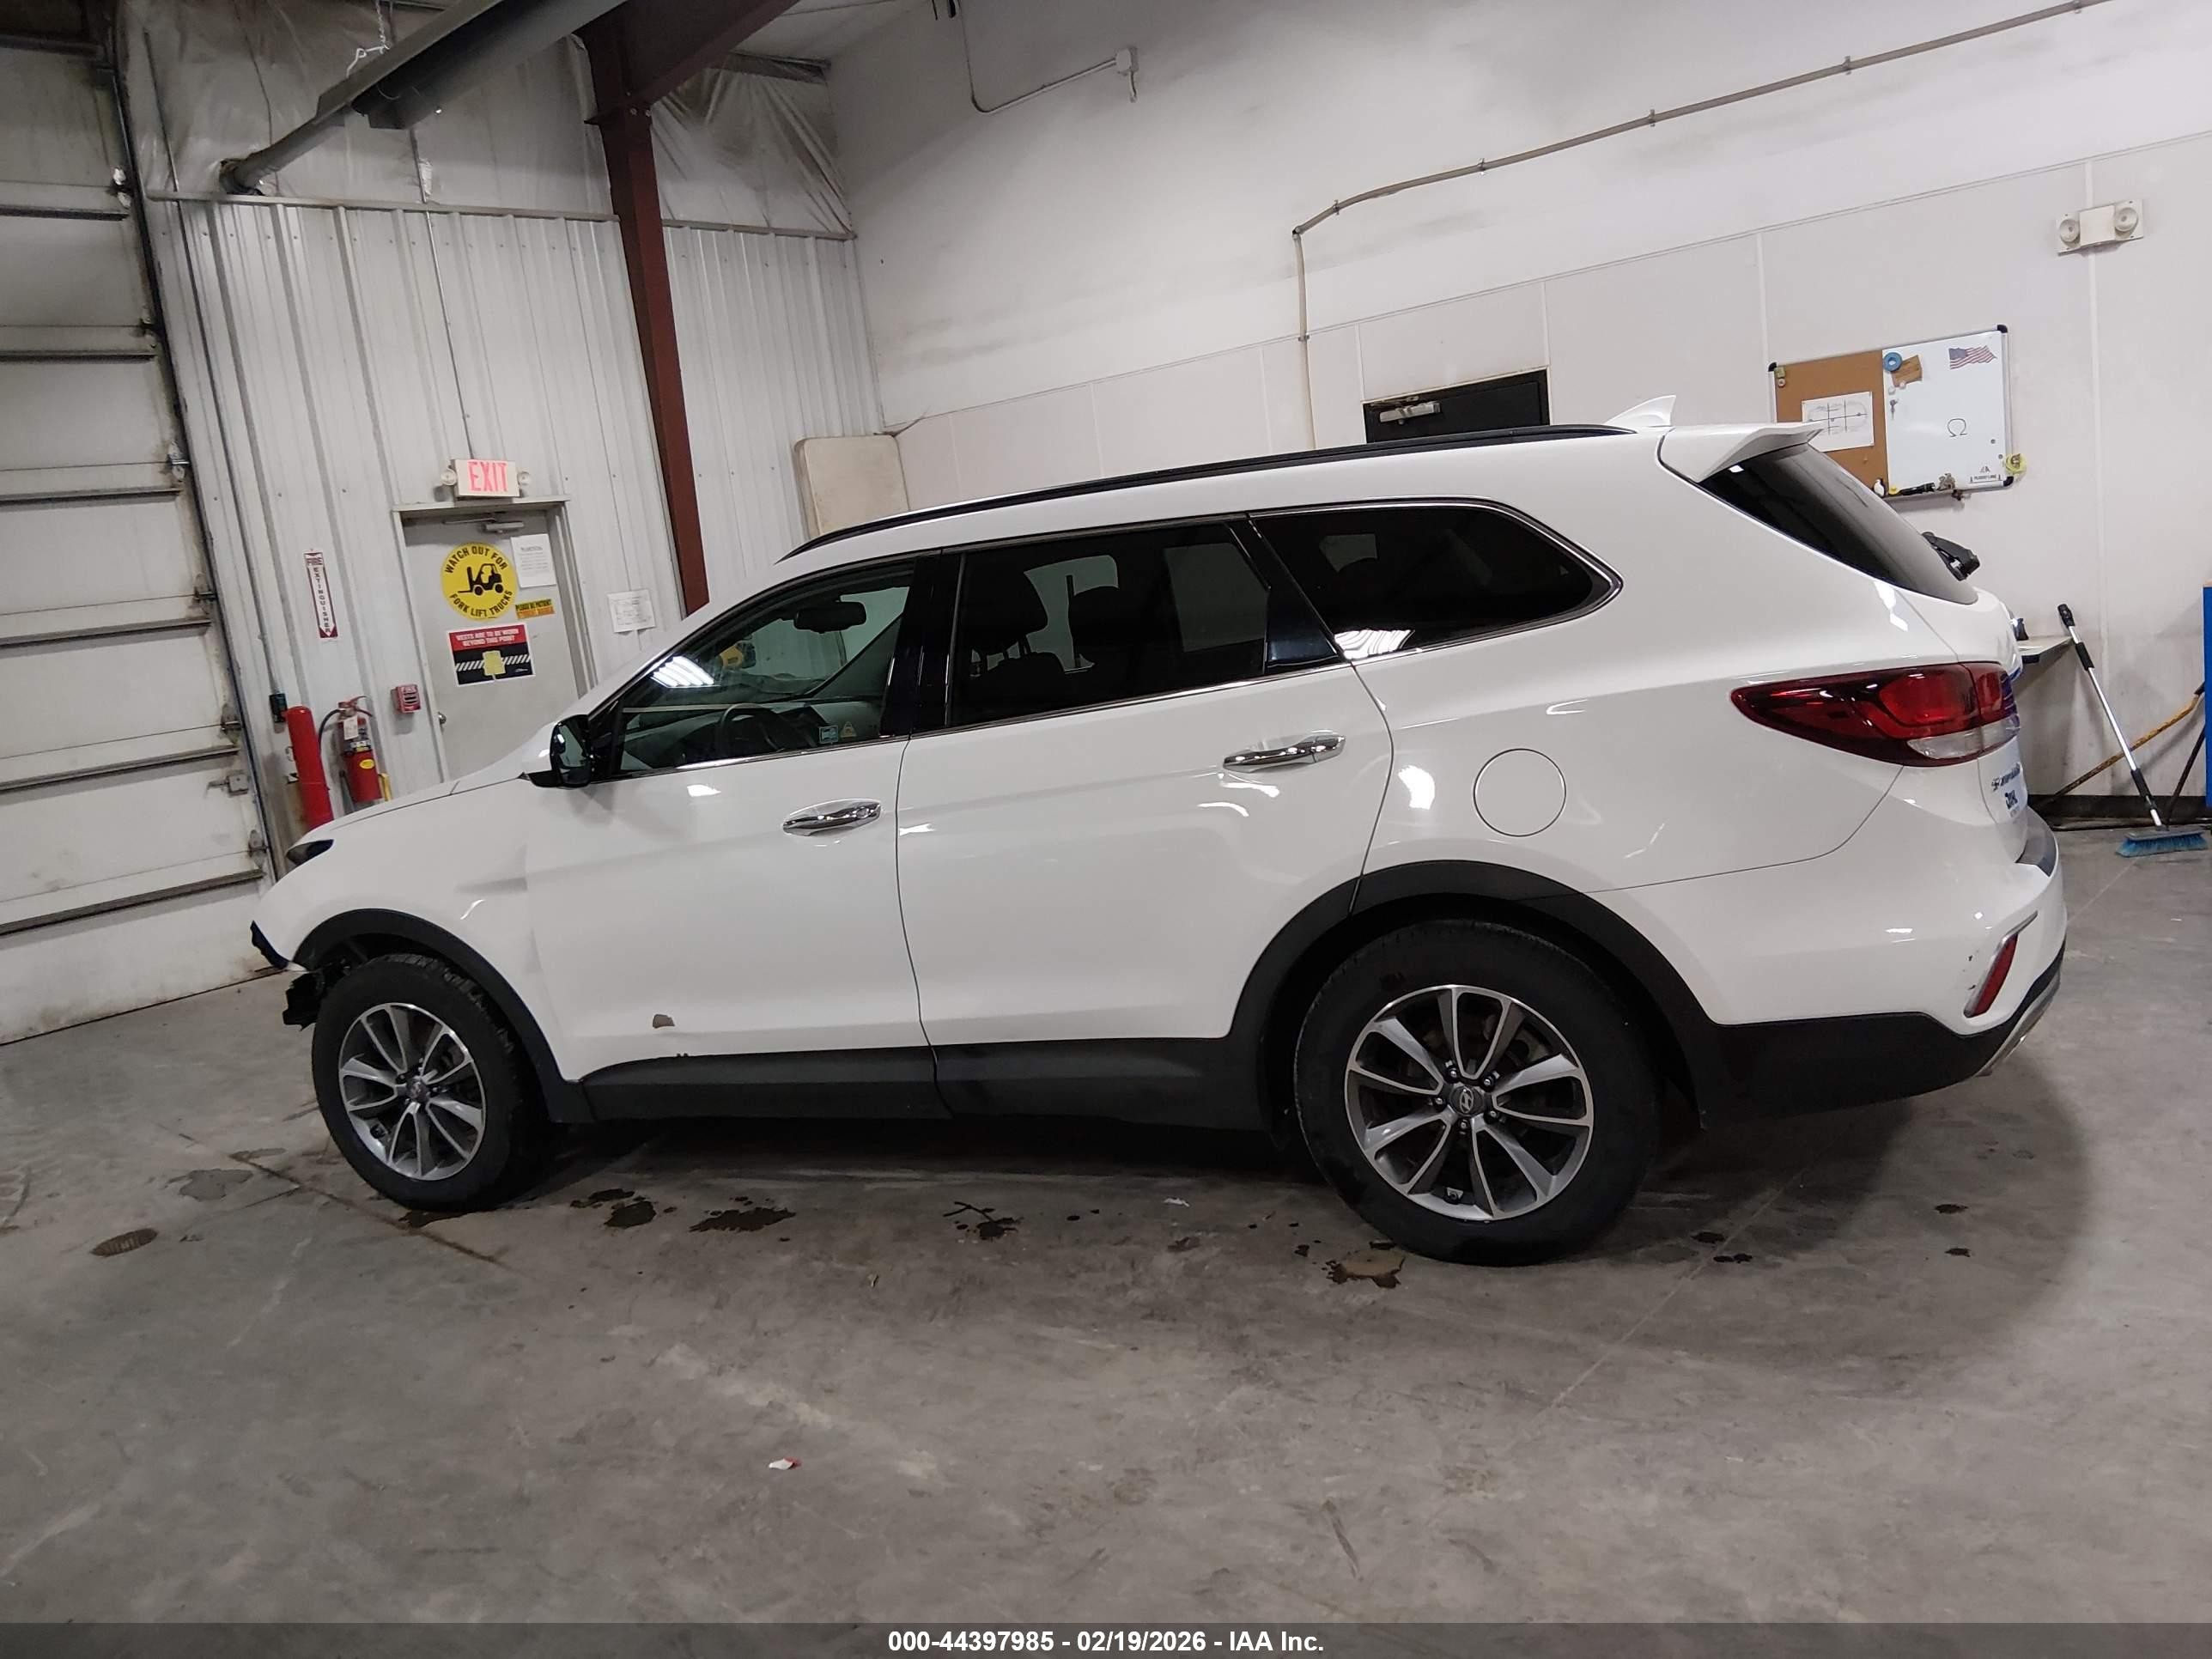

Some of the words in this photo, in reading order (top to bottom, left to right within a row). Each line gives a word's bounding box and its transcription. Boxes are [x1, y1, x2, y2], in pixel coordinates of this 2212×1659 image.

[467, 459, 507, 491] EXIT
[445, 548, 470, 574] WATCH
[471, 545, 490, 556] OUT
[490, 552, 508, 570] FOR
[313, 567, 331, 633] EXTINGUISHER
[449, 592, 469, 613] FORK
[470, 608, 488, 617] LIFT
[489, 590, 513, 616] TRUCKS
